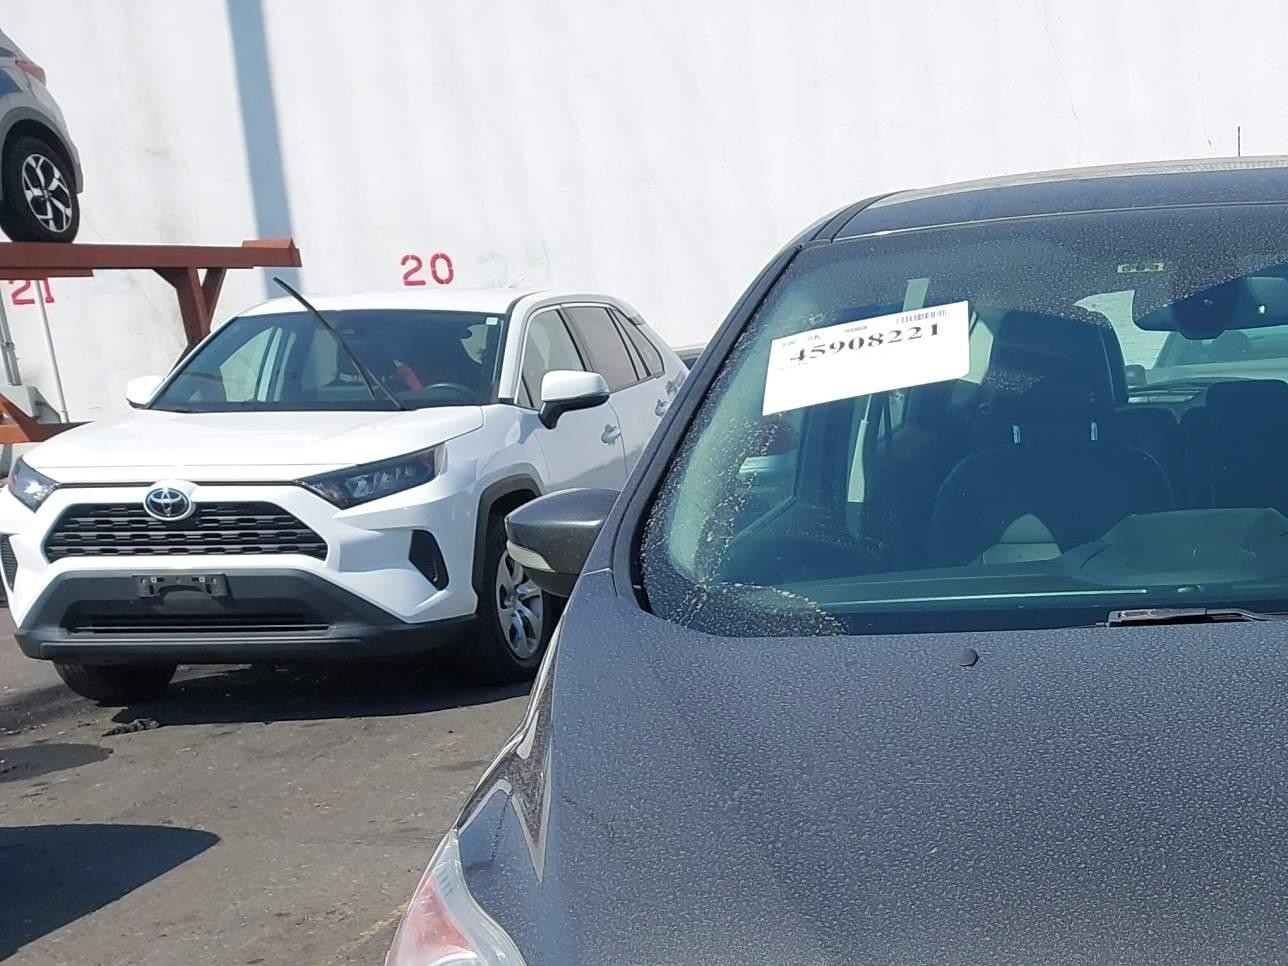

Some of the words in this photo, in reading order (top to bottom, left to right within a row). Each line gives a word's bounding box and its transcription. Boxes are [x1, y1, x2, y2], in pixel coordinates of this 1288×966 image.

[400, 252, 454, 287] 20
[11, 277, 55, 305] 21
[789, 322, 939, 362] 45908221
